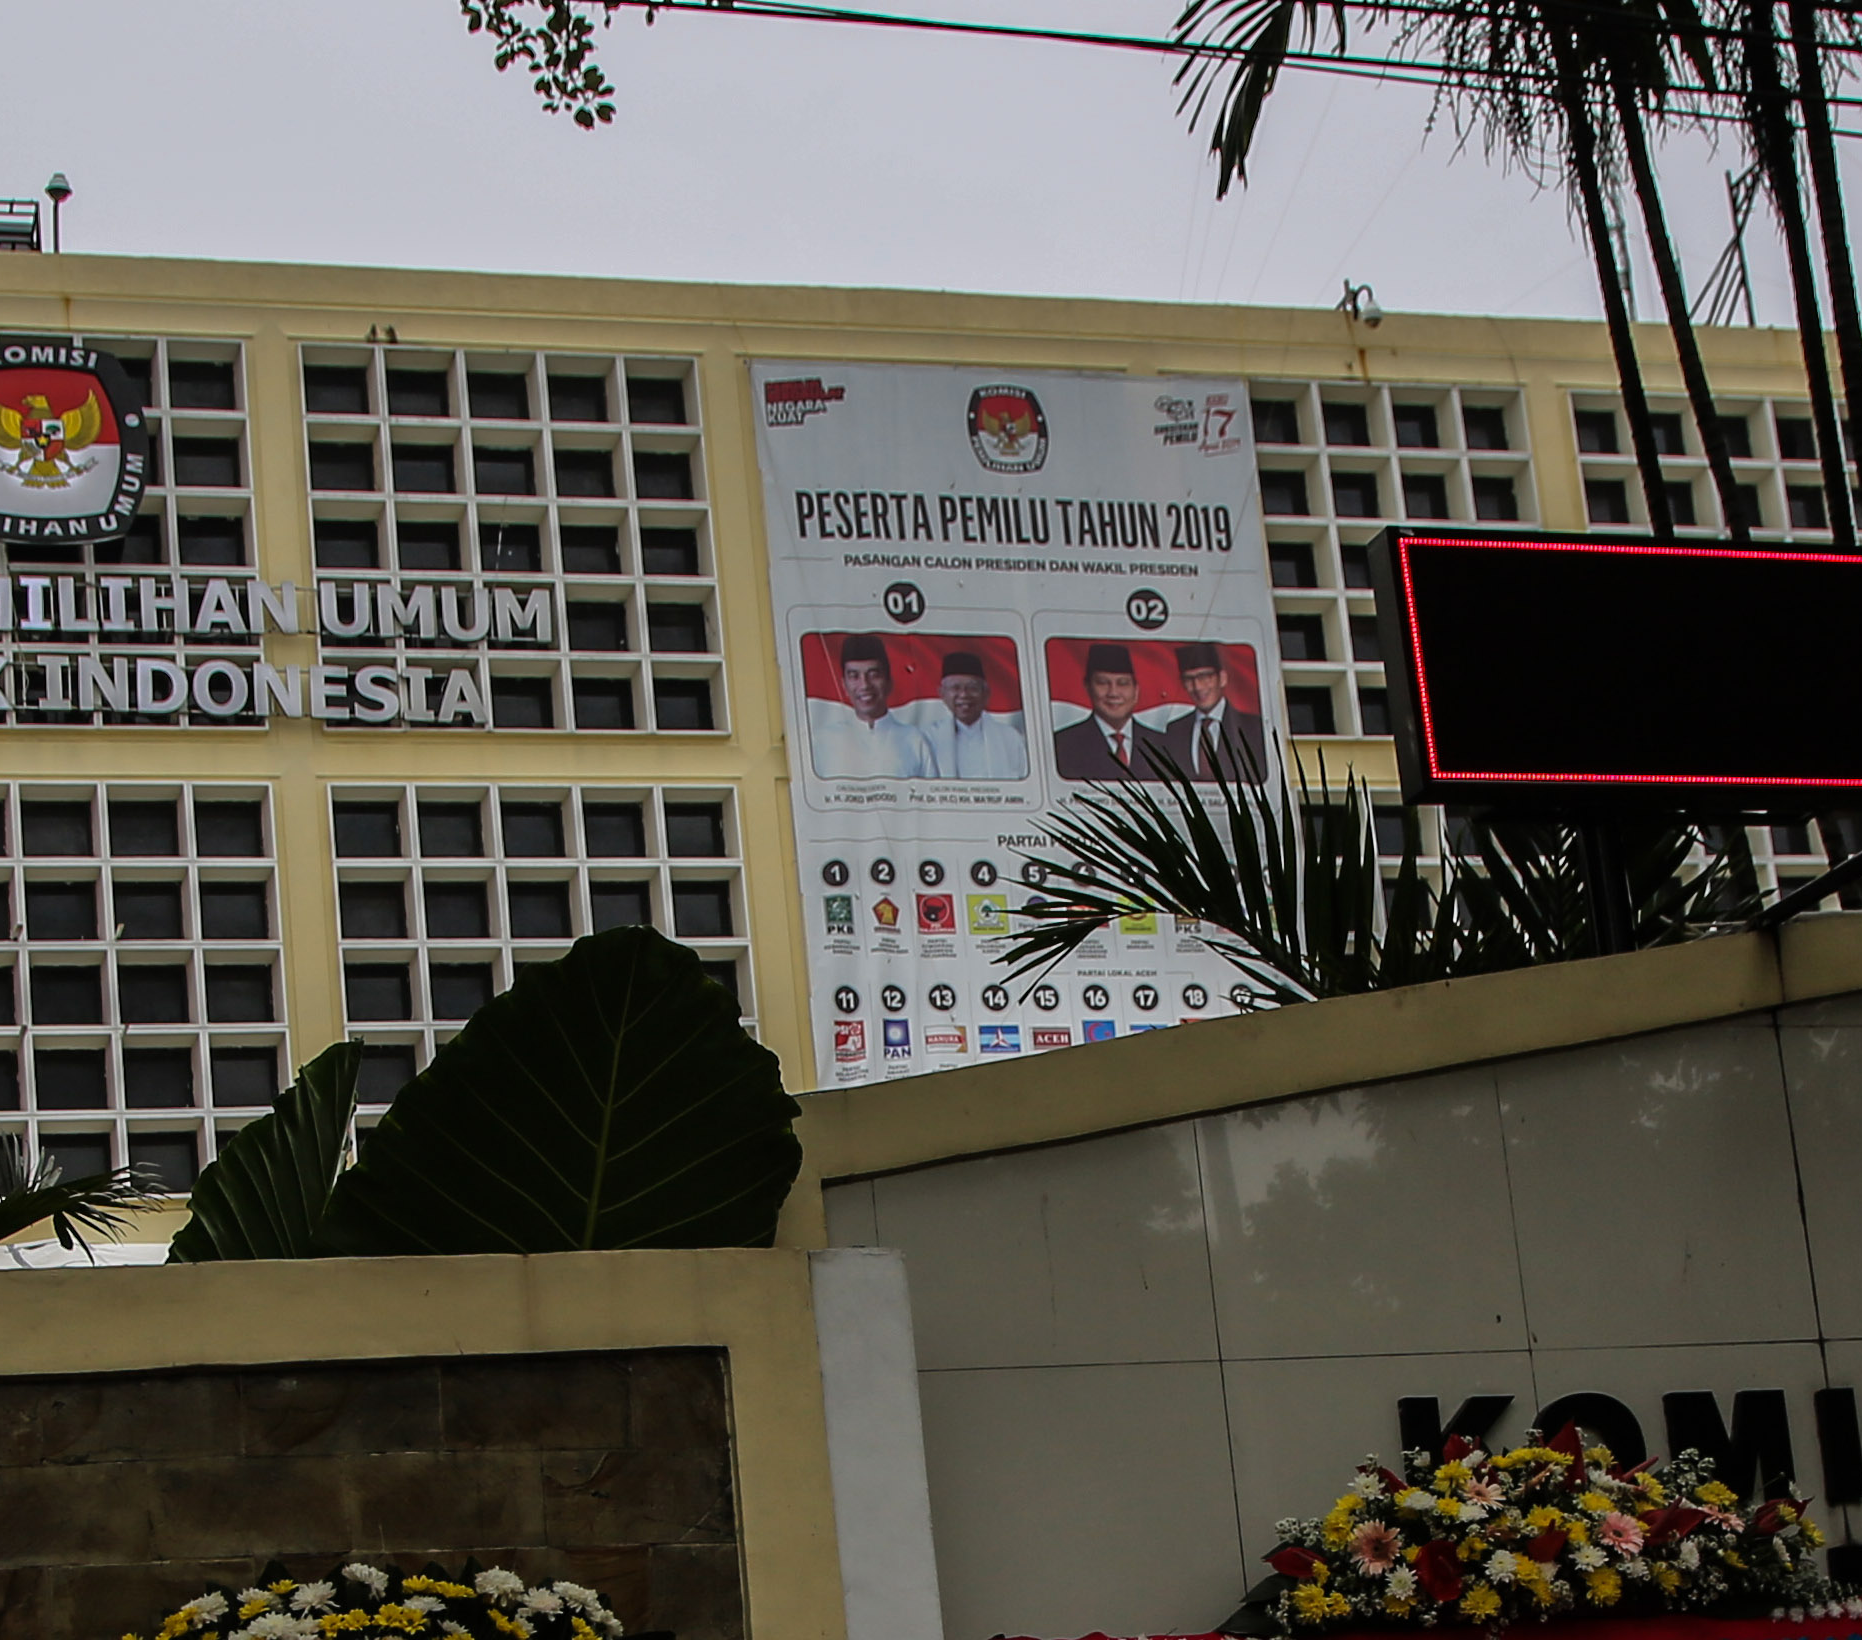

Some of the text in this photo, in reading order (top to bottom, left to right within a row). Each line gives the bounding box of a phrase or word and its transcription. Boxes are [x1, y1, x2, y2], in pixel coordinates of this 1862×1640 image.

[97, 453, 145, 531] UMUM
[794, 490, 1233, 552] PESERTA PEMILU TAHUN 2019
[844, 554, 1199, 578] PASANGAN CALON PRESIDEN DAN WAKIL PRESIDEN
[318, 579, 552, 644] UMUM
[888, 590, 921, 615] 01
[1130, 598, 1168, 622] 02
[35, 653, 488, 725] INDONESIA
[998, 835, 1047, 848] PARTAI
[838, 991, 855, 1009] 11
[883, 989, 902, 1008] 12
[931, 989, 954, 1006] 13
[984, 989, 1007, 1007] 14
[1035, 989, 1056, 1006] 15
[1085, 989, 1107, 1006] 16
[1135, 989, 1156, 1006] 17
[1184, 989, 1205, 1006] 18
[1036, 1033, 1069, 1044] ACEH
[883, 1047, 911, 1059] PAN
